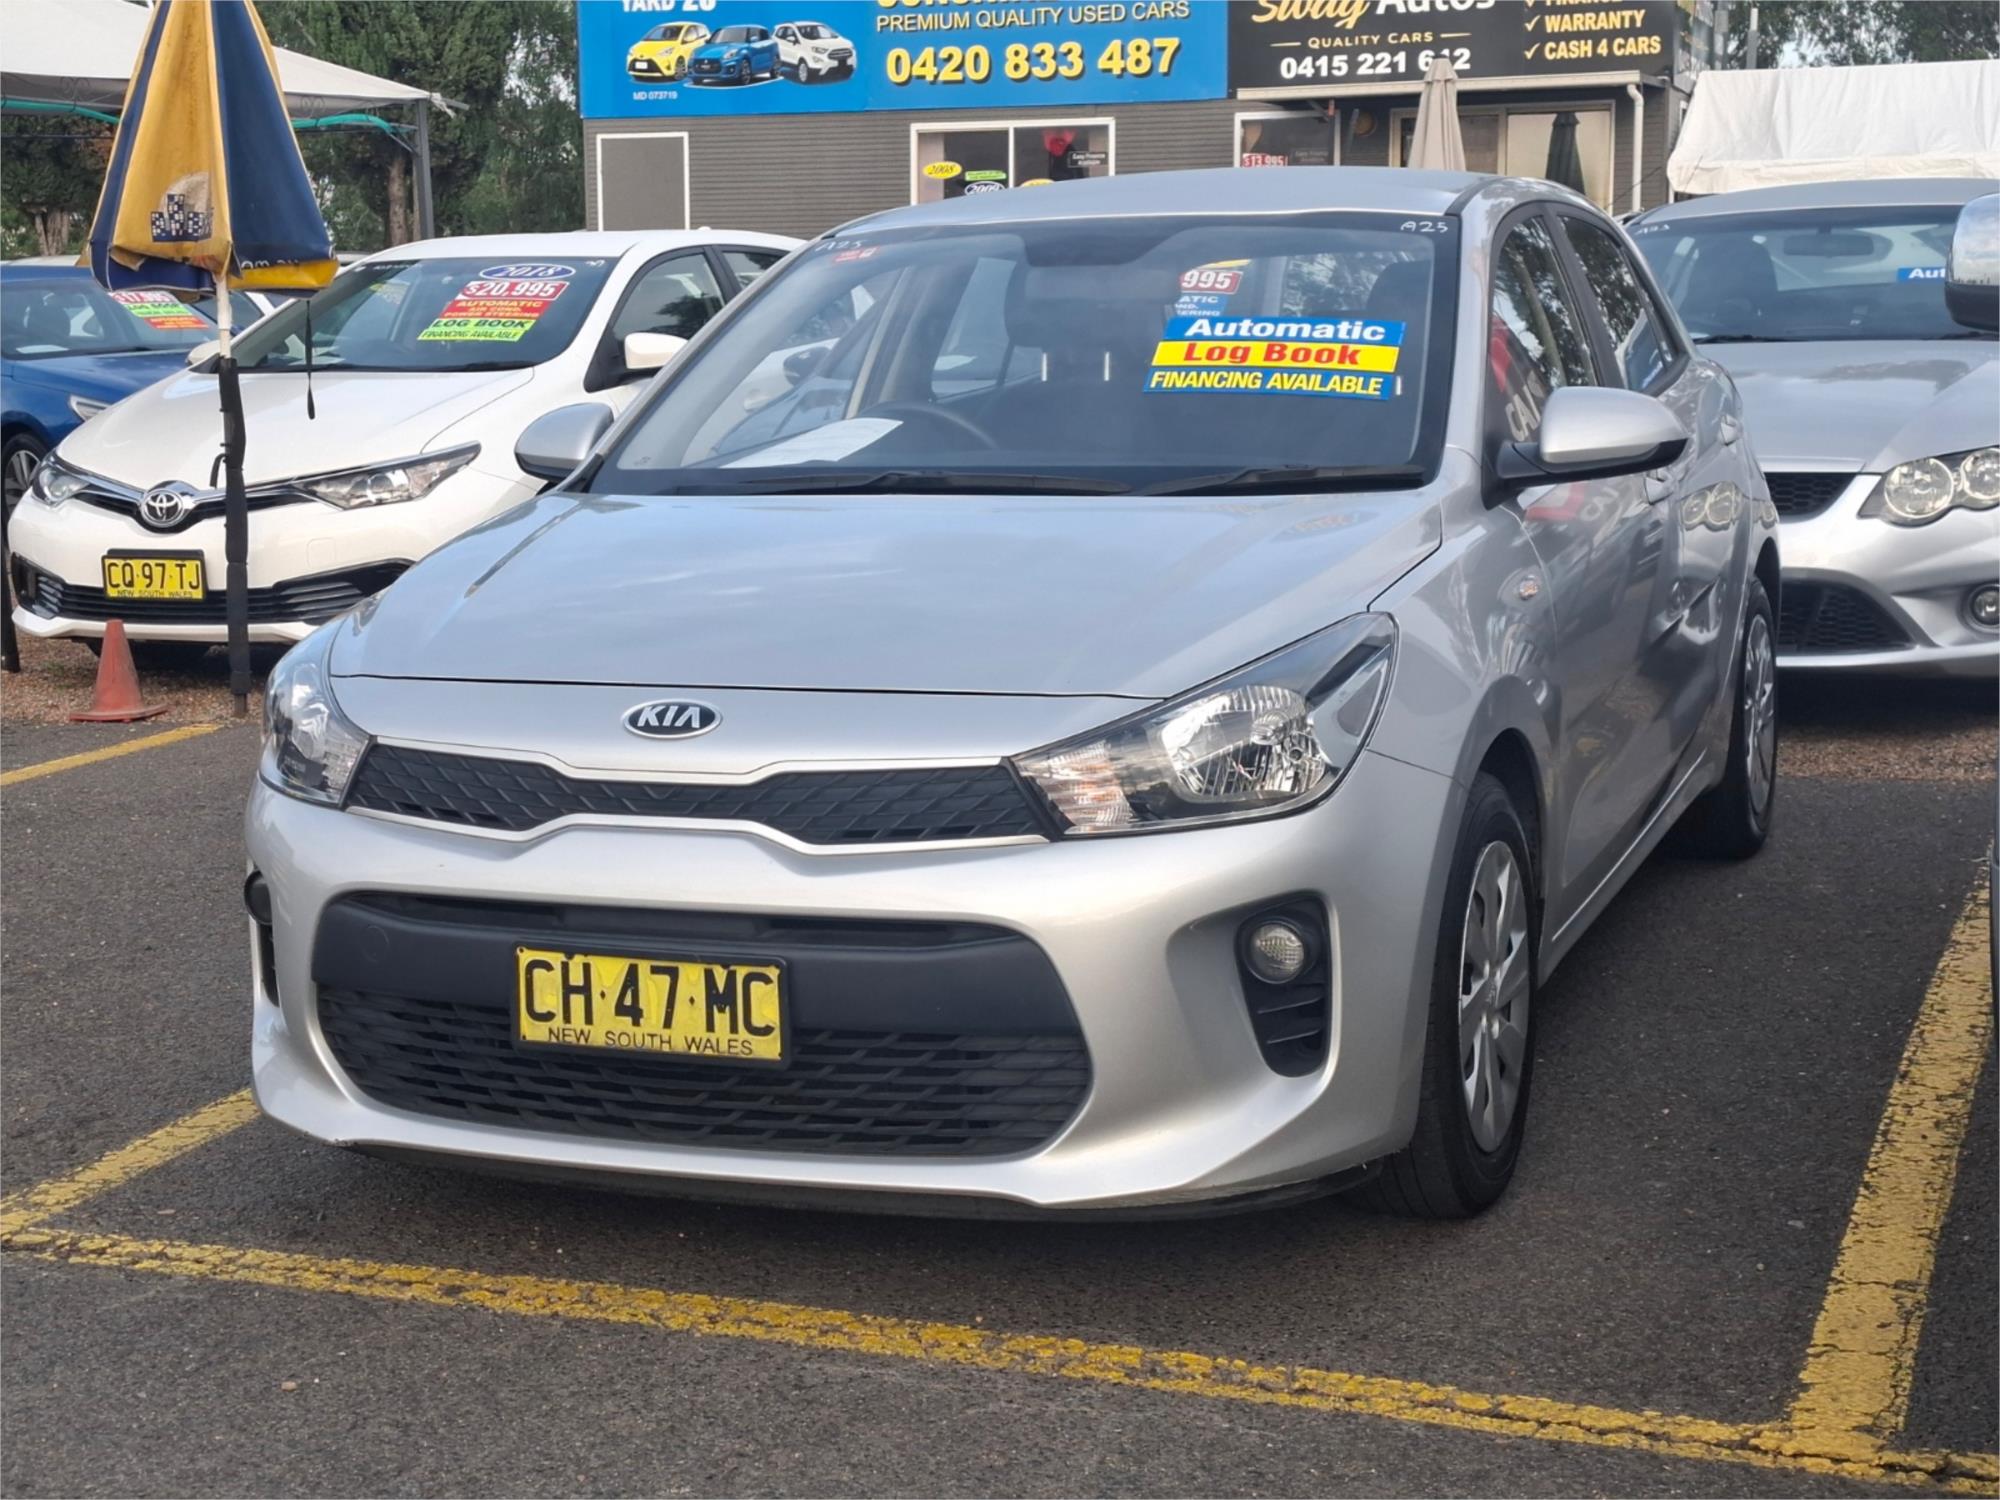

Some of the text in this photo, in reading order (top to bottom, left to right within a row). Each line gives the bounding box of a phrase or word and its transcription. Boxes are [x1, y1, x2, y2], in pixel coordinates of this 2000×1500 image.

[876, 0, 1190, 32] PREMIUM QUALITY USED CARS
[1545, 9, 1646, 33] WARRANTY
[1308, 31, 1434, 49] QUALITY CARS
[1544, 35, 1662, 61] CASH 4 CARS
[886, 37, 1182, 84] 0420 833 487
[1280, 47, 1472, 80] 0415 221 62
[633, 90, 647, 100] MD
[1400, 221, 1449, 233] A25
[494, 265, 562, 278] 2018
[466, 281, 557, 299] $20,995
[456, 300, 543, 308] AUTOMATIC
[431, 319, 528, 329] LOG BOOK
[1184, 318, 1387, 341] Automatic
[1183, 342, 1361, 366] Log Book
[1150, 371, 1383, 396] FINANCING AVAILABLE
[637, 705, 700, 729] KIA
[547, 1026, 754, 1056] NEW SOUTH WALES
